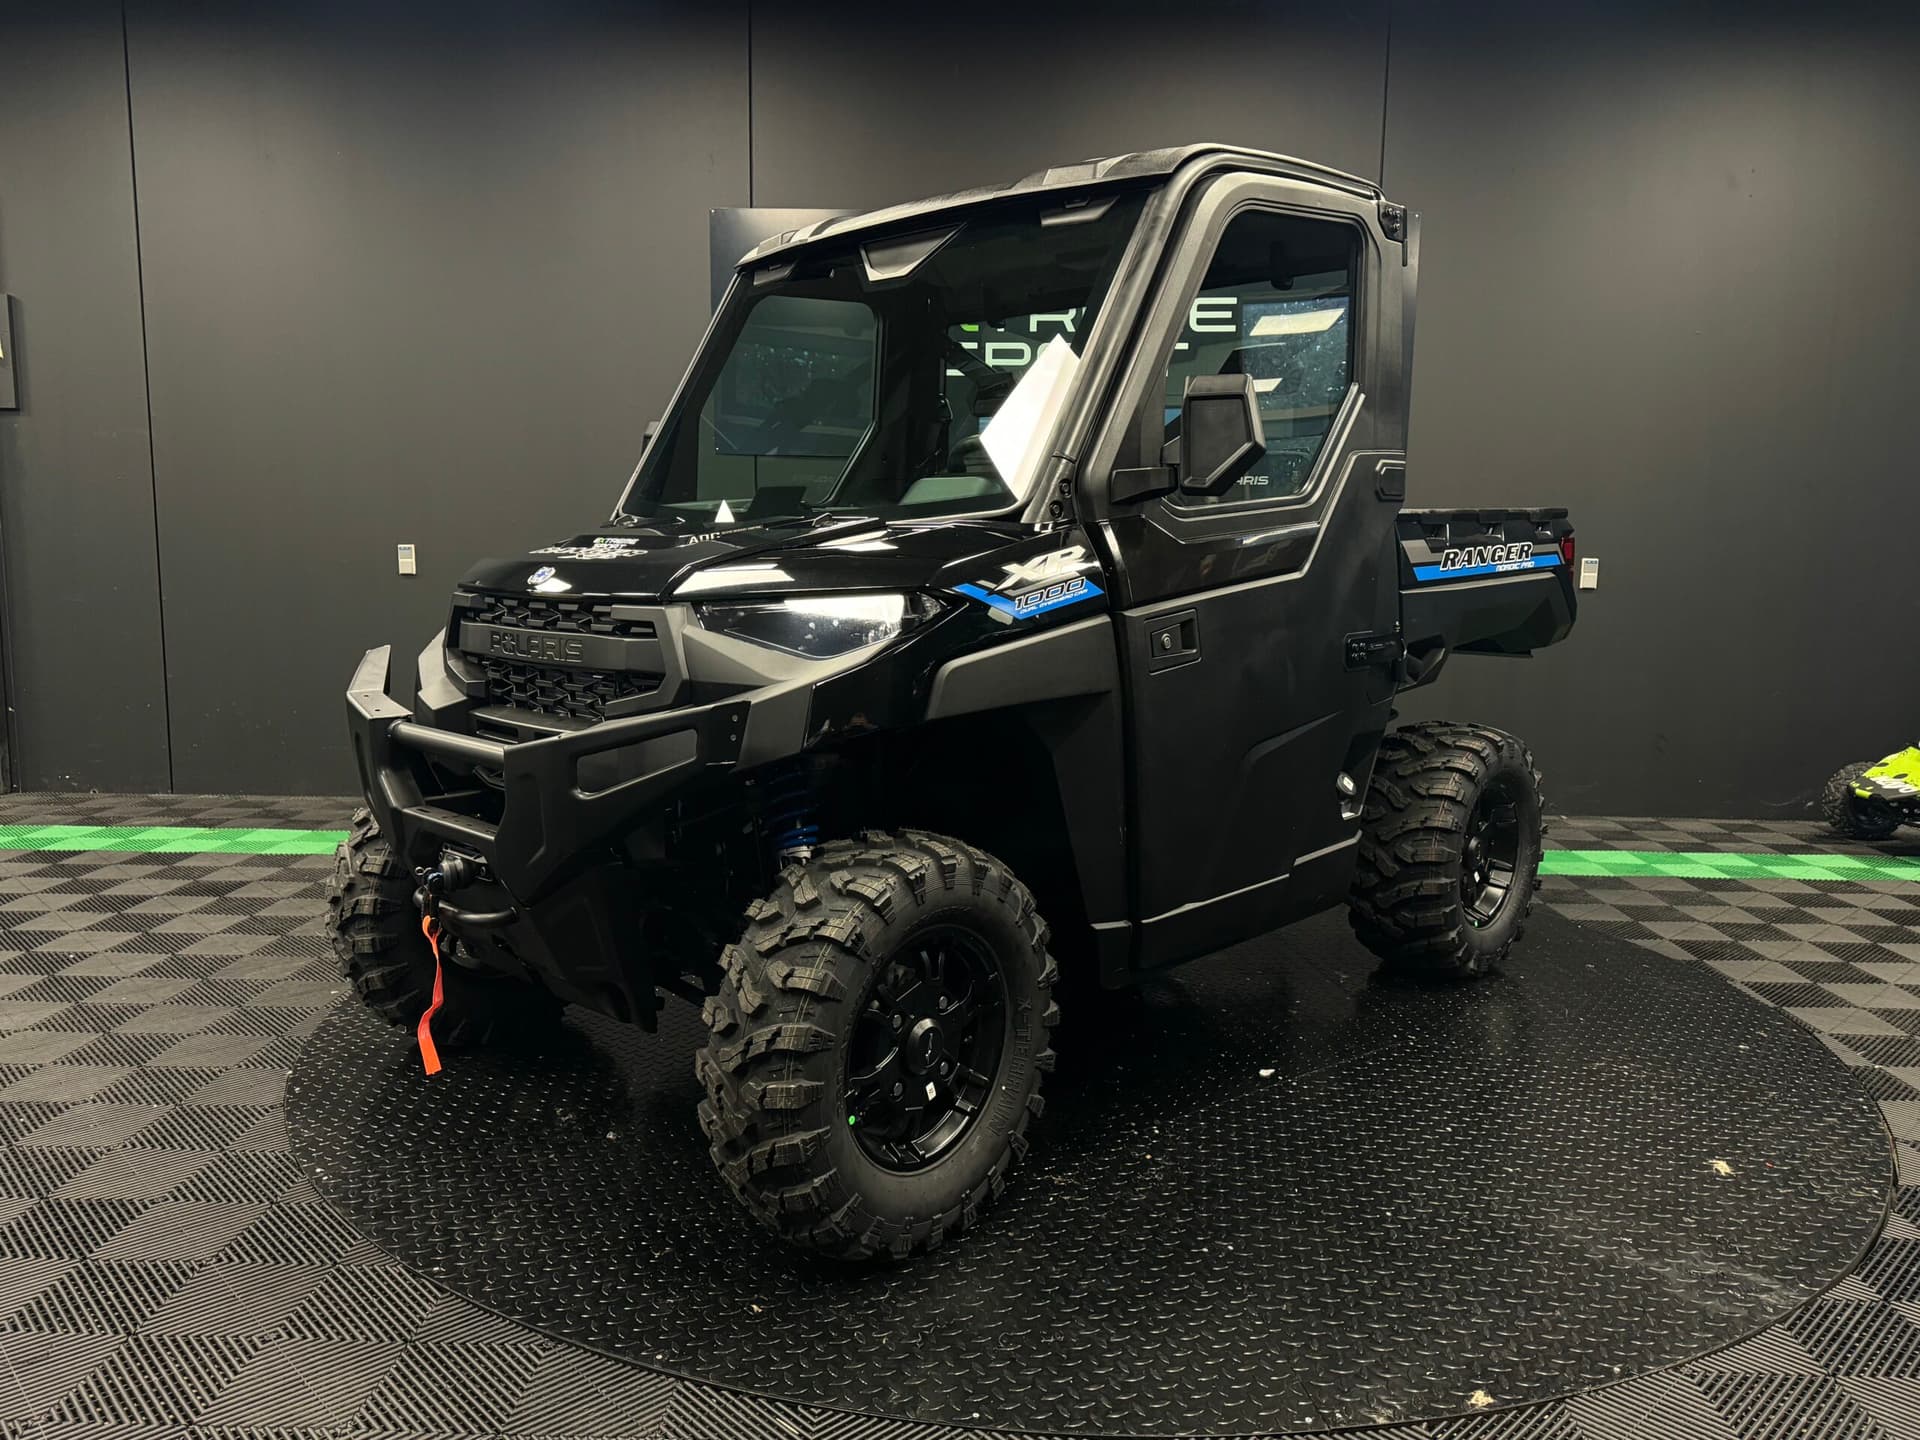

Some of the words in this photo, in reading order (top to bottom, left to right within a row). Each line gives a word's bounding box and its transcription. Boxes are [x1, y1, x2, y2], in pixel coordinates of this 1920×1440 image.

[995, 545, 1087, 591] XP
[1439, 541, 1534, 571] RANGER
[1015, 576, 1087, 611] 1000
[490, 630, 584, 663] POLARIS
